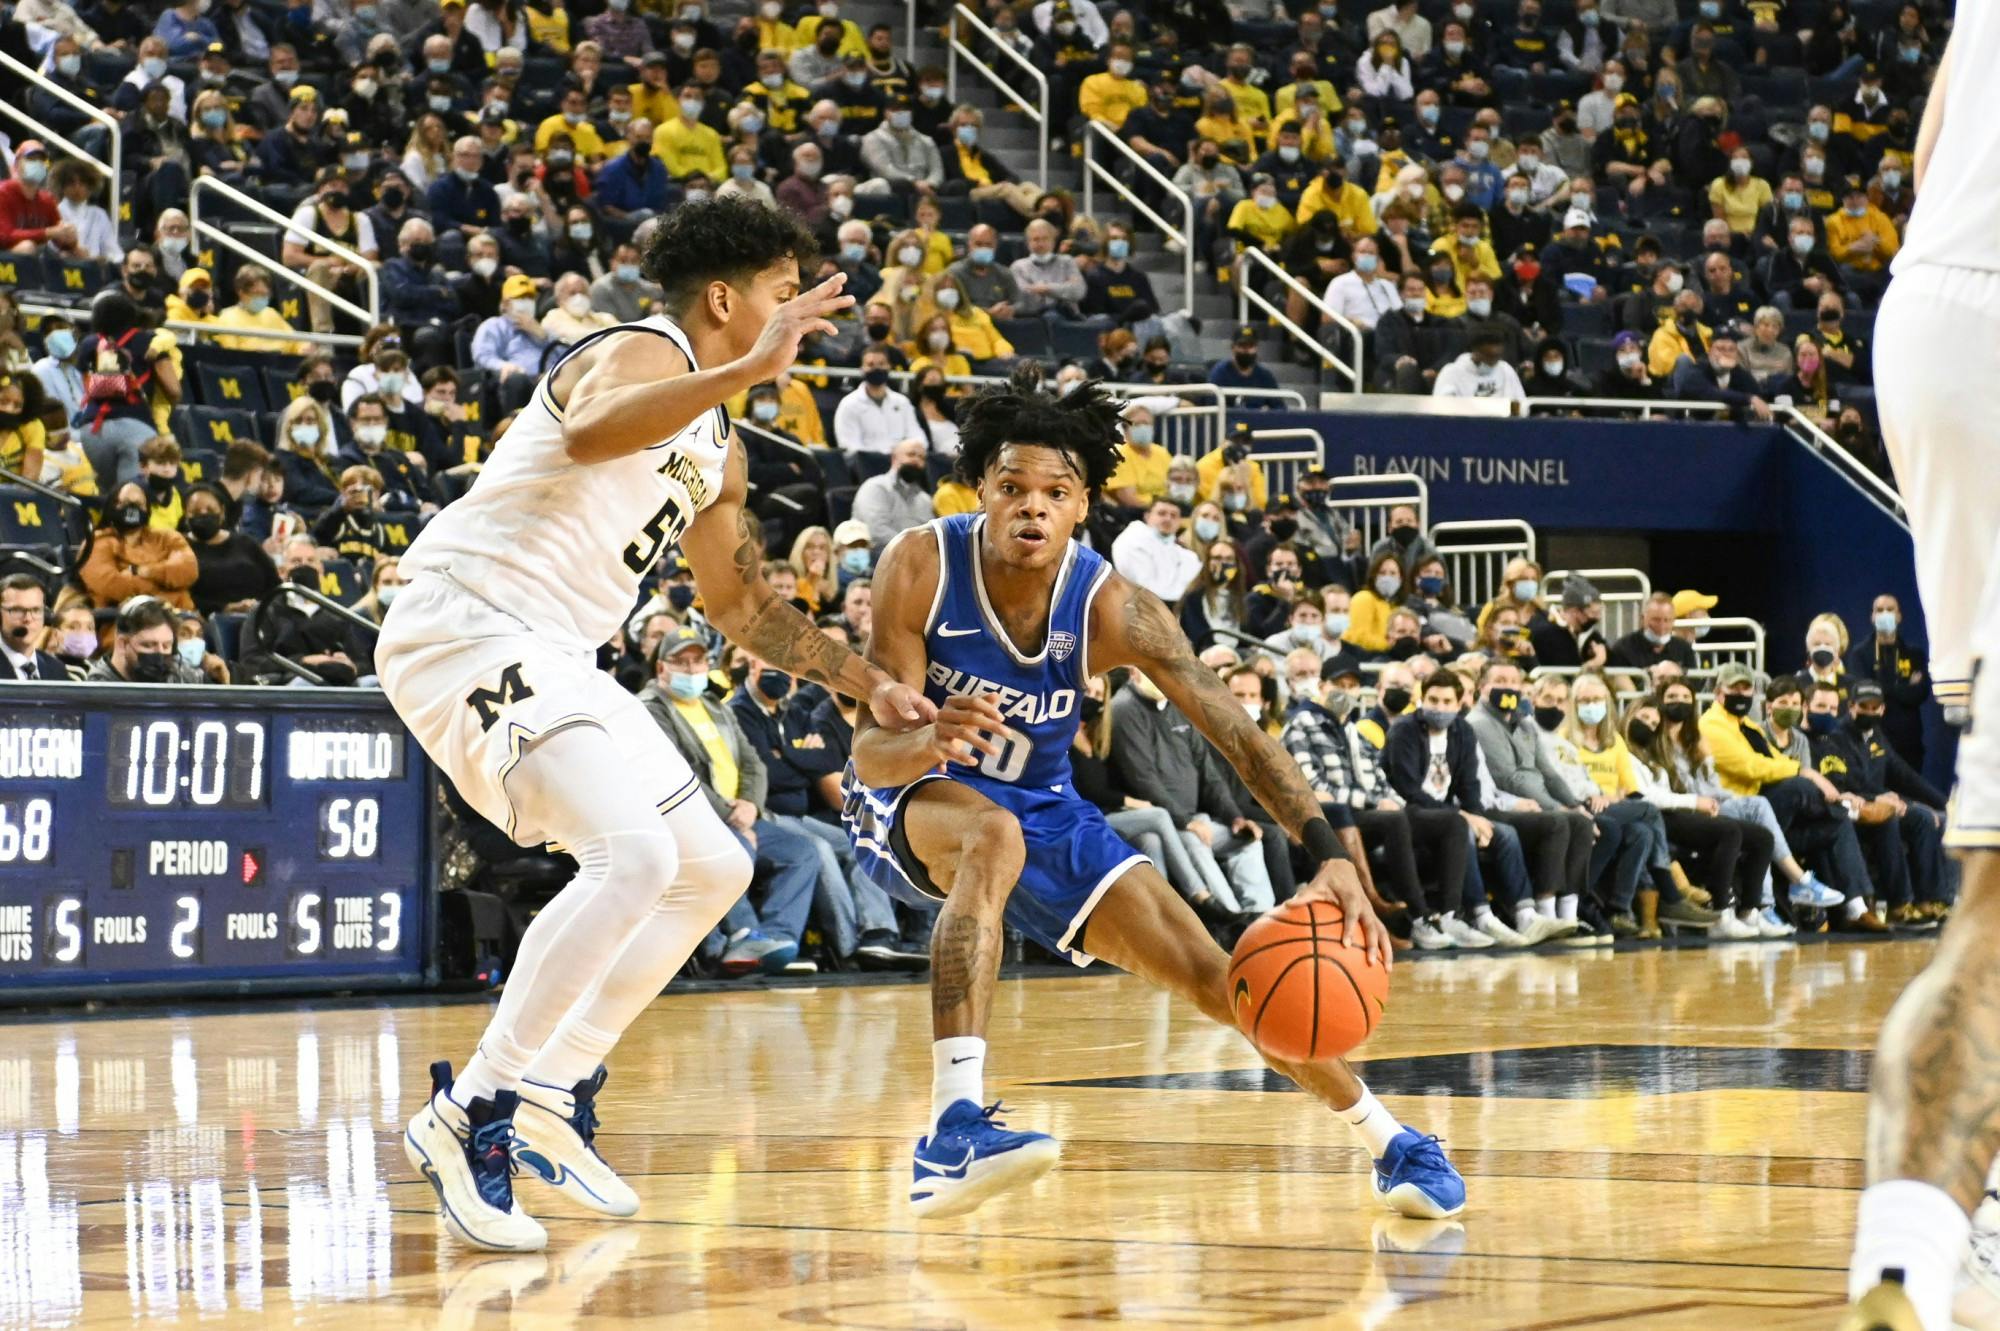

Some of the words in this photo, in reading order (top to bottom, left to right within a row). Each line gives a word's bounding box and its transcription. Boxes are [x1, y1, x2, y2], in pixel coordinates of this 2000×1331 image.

[64, 268, 85, 288] M
[282, 298, 299, 318] M
[218, 378, 242, 399] M
[209, 420, 236, 443] M
[181, 462, 203, 484] M
[656, 451, 708, 513] MICHIGA
[1353, 454, 1449, 482] BLAVIN
[1461, 456, 1569, 486] TUNNEL
[14, 502, 42, 527] M
[384, 523, 409, 546] M
[466, 661, 535, 734] M
[926, 660, 1075, 725] BUFFALO
[1500, 693, 1517, 710] M
[127, 721, 264, 805] 10:07
[288, 730, 392, 780] BUFFALO
[328, 798, 379, 857] 58
[149, 840, 228, 876] PERIOD
[296, 893, 321, 954] 5
[334, 897, 373, 923] TIME
[376, 892, 402, 951] 3
[55, 899, 81, 962] 5
[93, 915, 147, 945] FOULS
[171, 896, 200, 958] 2
[226, 912, 278, 941] FOULS
[333, 923, 373, 949] OUTS
